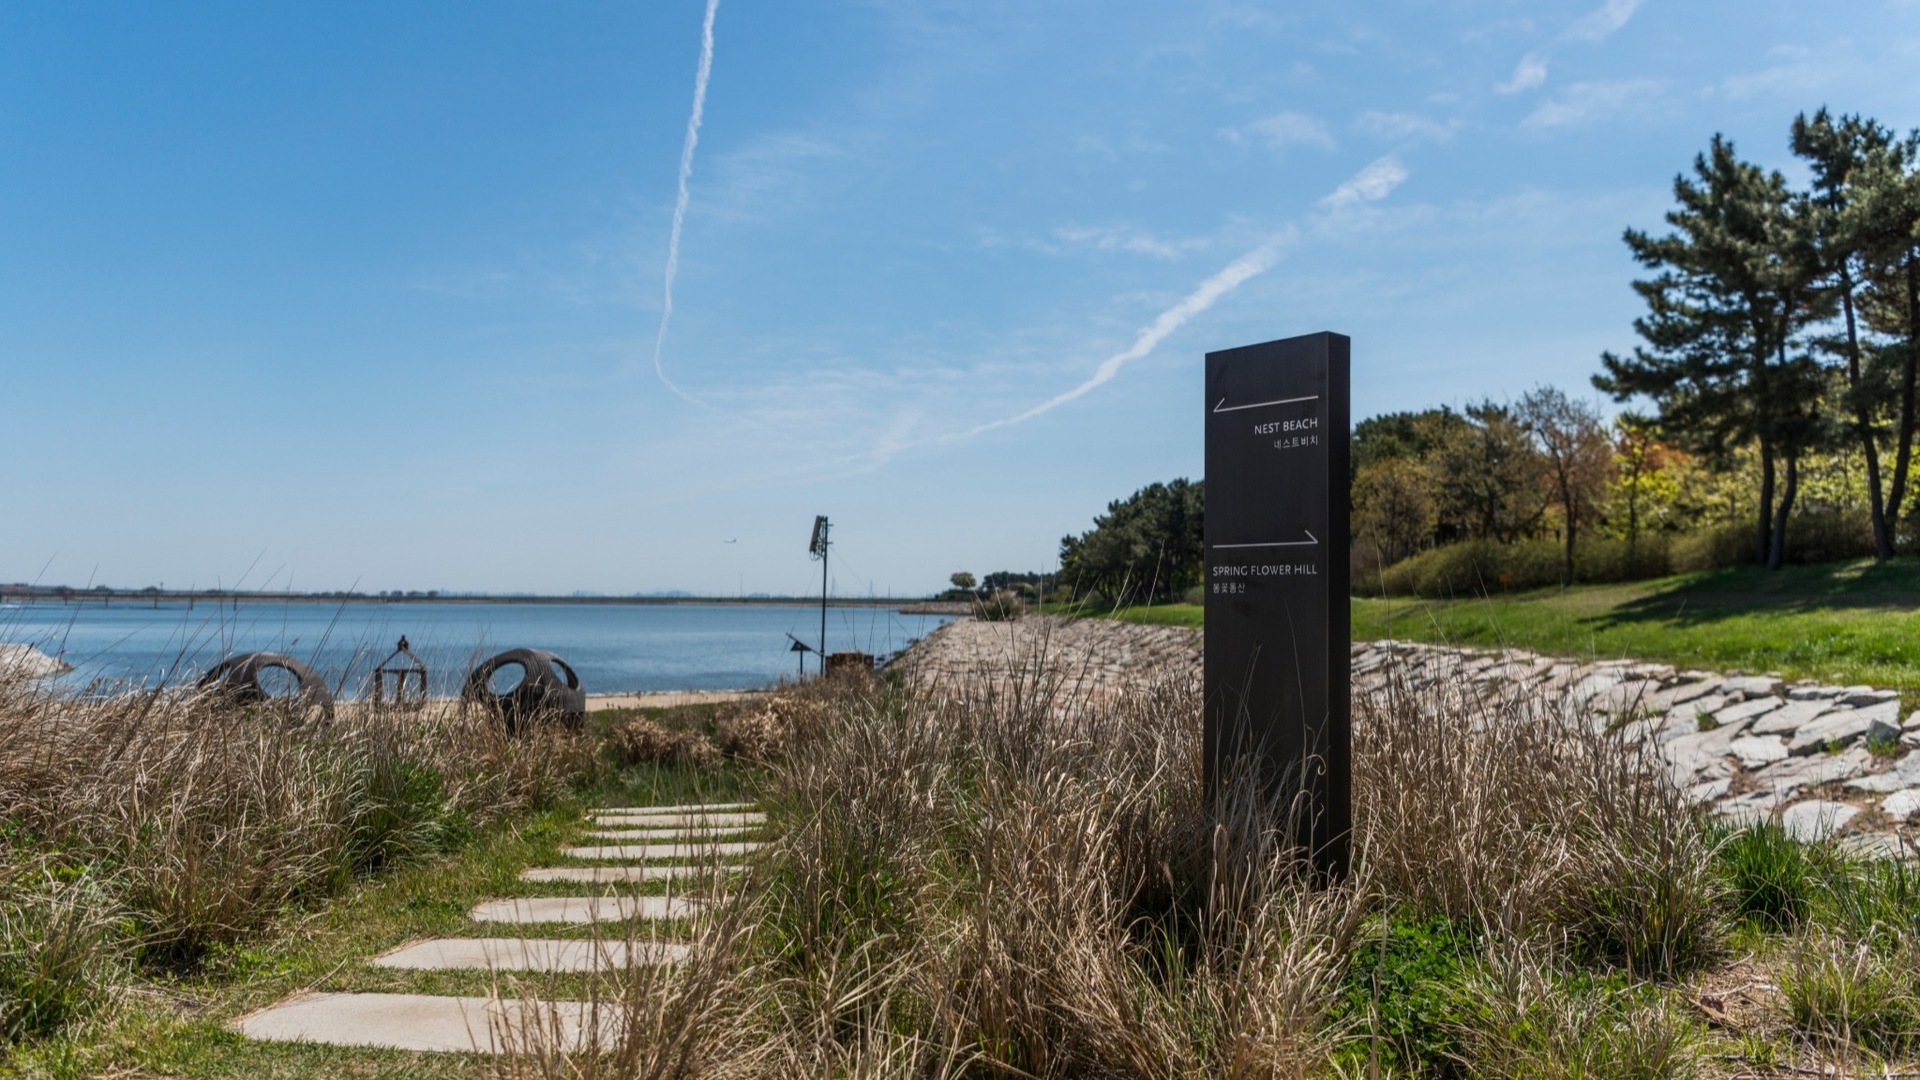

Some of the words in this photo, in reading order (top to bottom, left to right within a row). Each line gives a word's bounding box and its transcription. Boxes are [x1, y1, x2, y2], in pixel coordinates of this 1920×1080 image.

[1254, 422, 1280, 435] NEST
[1283, 417, 1318, 432] BEACH
[1273, 435, 1318, 449] 네스트비치
[1212, 565, 1248, 577] SPRING
[1251, 565, 1291, 576] FLOWER
[1294, 564, 1318, 575] HILL
